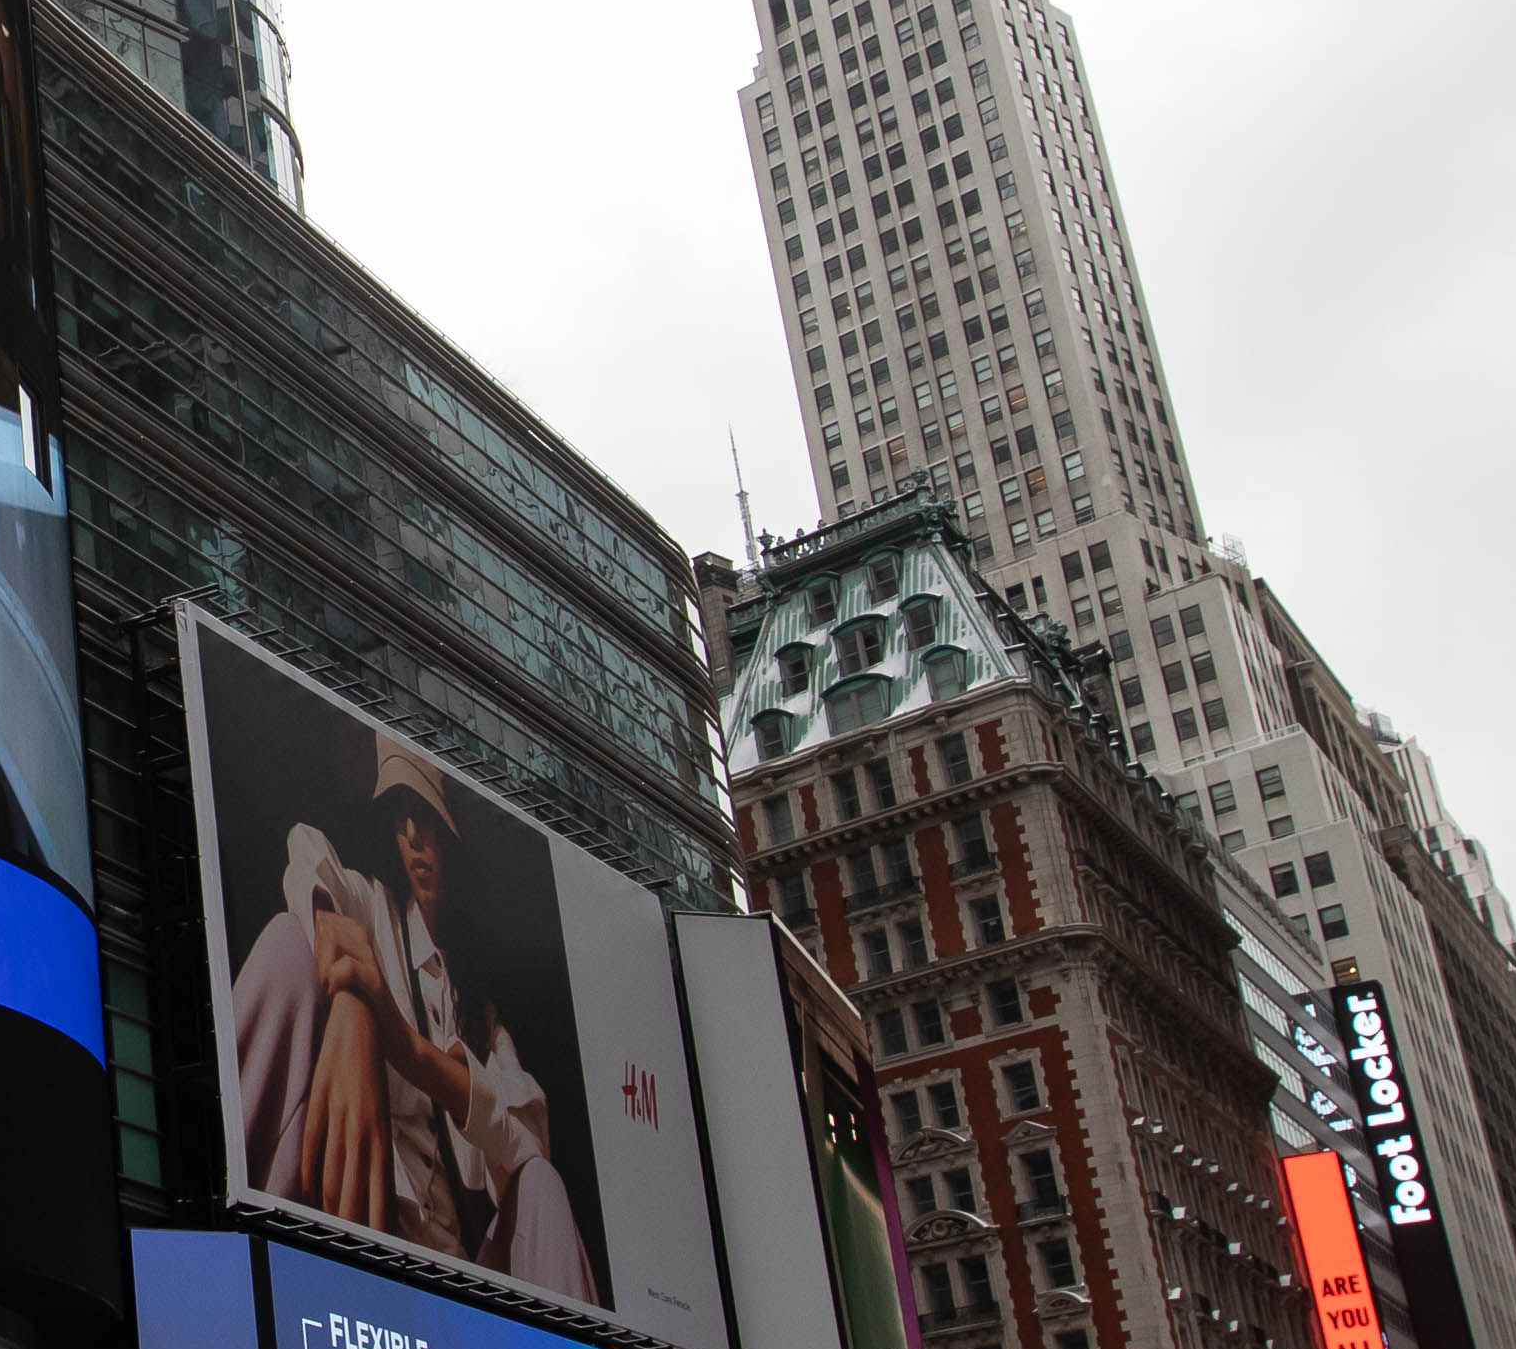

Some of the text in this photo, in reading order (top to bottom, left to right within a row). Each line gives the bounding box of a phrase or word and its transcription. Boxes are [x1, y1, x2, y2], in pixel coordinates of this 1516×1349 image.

[622, 1060, 659, 1133] H&M
[1347, 995, 1432, 1225] Foot Locker
[1322, 1274, 1362, 1298] ARE
[1327, 1307, 1370, 1330] YOU
